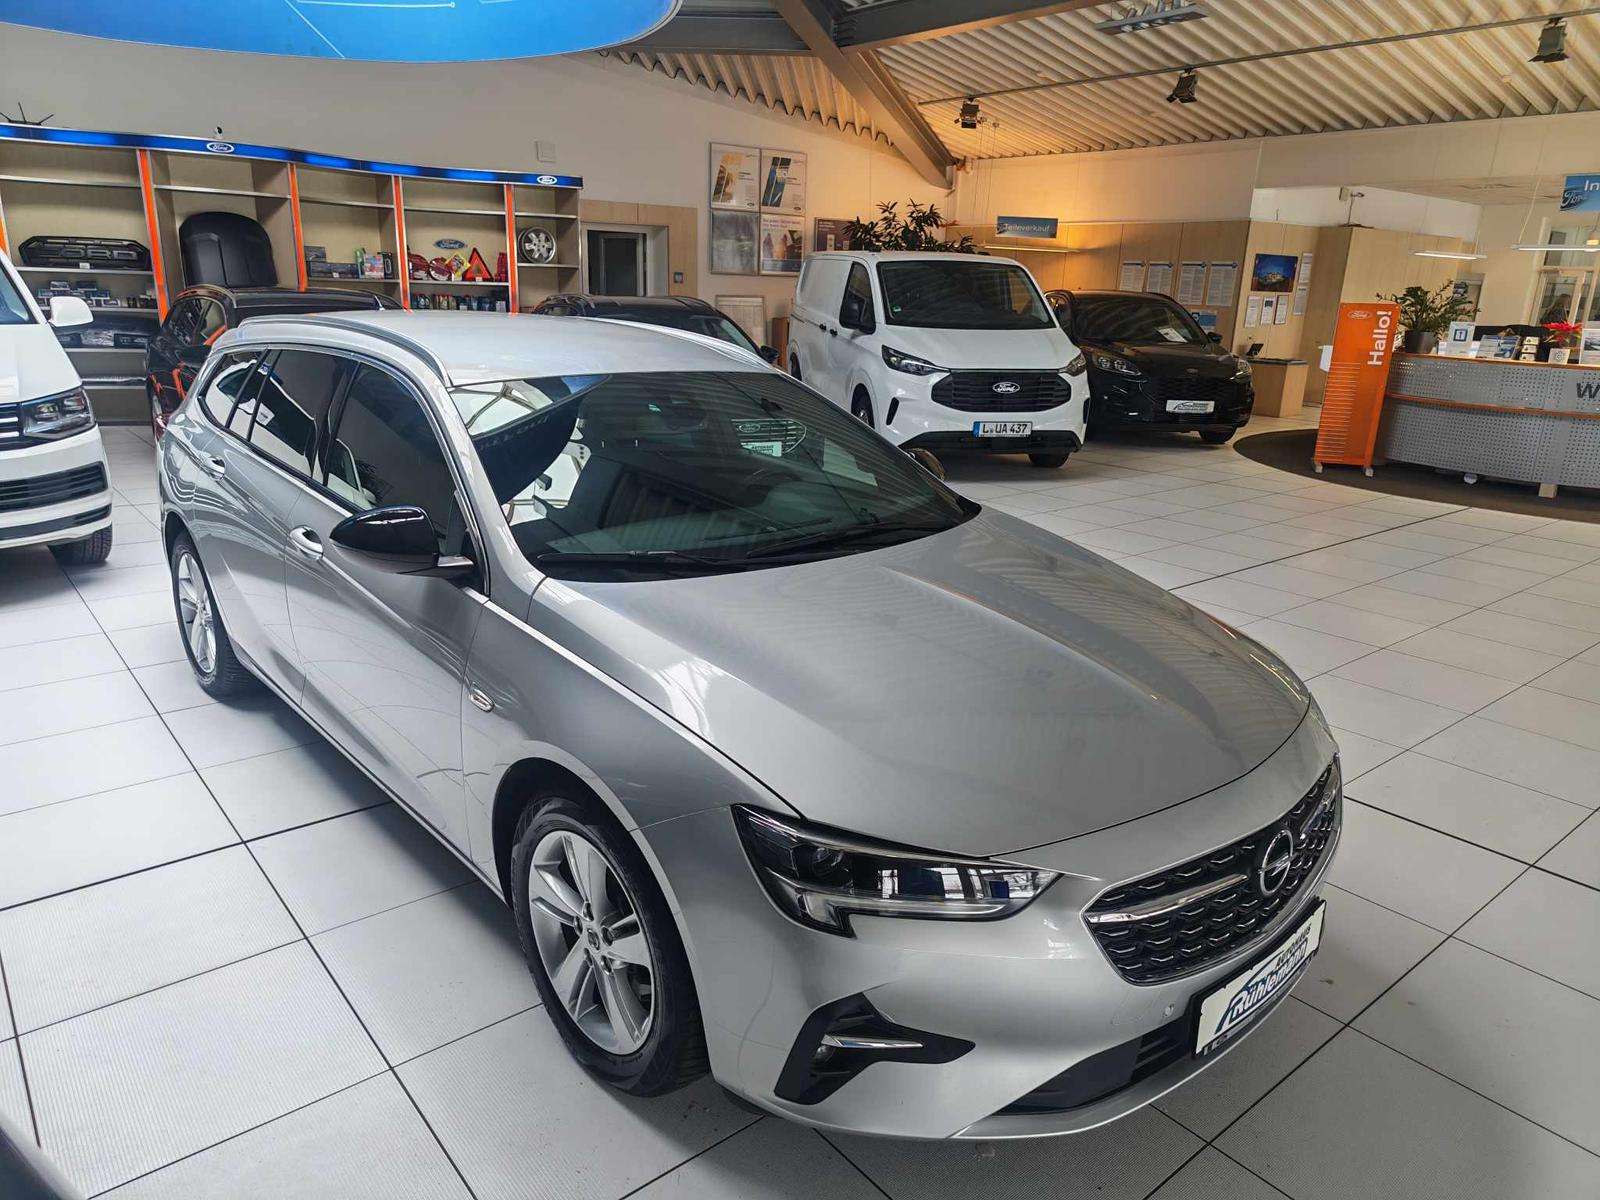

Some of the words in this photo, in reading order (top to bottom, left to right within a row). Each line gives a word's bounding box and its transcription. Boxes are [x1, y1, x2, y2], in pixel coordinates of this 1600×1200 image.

[1367, 311, 1392, 366] Hallo!
[995, 383, 1016, 393] Ford
[995, 423, 1008, 433] UA
[1010, 423, 1028, 433] 437
